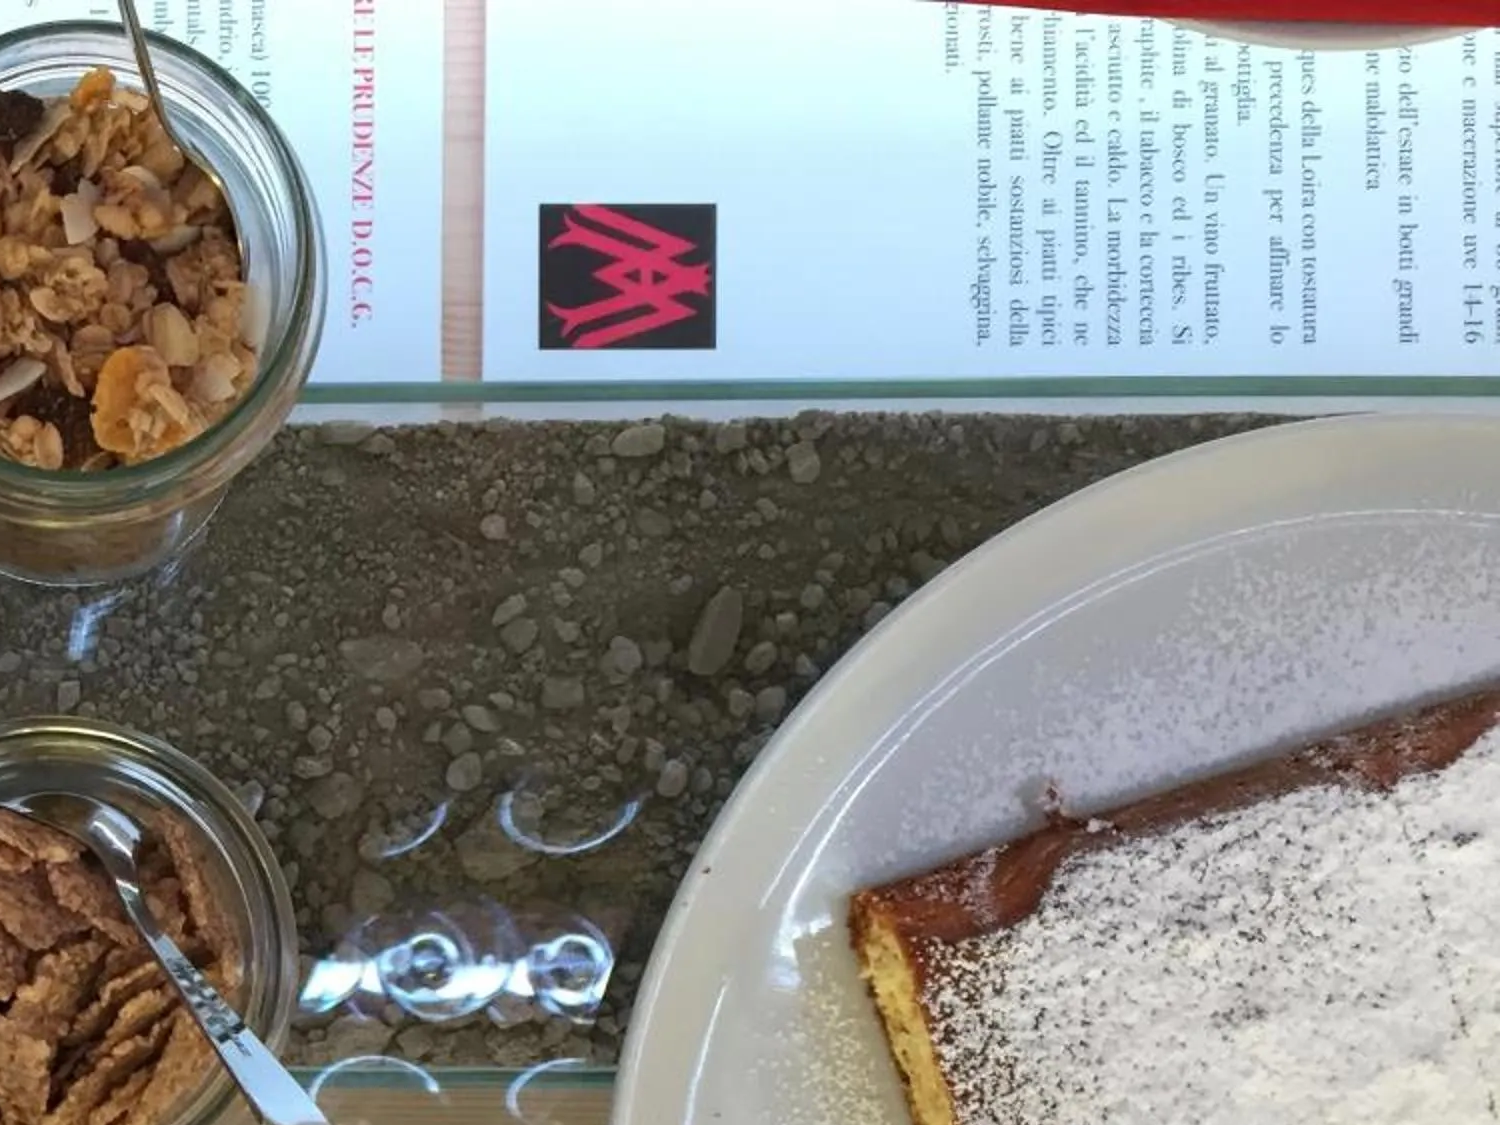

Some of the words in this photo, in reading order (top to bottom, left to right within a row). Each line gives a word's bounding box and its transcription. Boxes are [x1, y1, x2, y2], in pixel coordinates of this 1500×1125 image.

[1009, 77, 1030, 94] ai
[1204, 56, 1226, 72] al
[972, 70, 997, 148] pollame
[1139, 110, 1160, 123] il
[1171, 90, 1194, 109] di
[351, 68, 375, 210] PRUDENZE
[1004, 109, 1030, 161] piatti
[1074, 119, 1095, 144] ed
[1301, 101, 1322, 147] della
[1365, 82, 1387, 190] malolattica
[1042, 130, 1064, 184] Oltre
[1075, 156, 1095, 168] il
[1107, 129, 1128, 187] caldo.
[1139, 130, 1160, 207] tabacco
[1171, 124, 1193, 182] bosco
[1463, 99, 1482, 224] macerazione
[1204, 173, 1225, 203] Un
[1301, 155, 1322, 208] Loira
[1398, 195, 1418, 214] in
[1042, 198, 1062, 215] ai
[1073, 179, 1091, 263] tannino,
[1107, 198, 1129, 223] La
[1171, 196, 1193, 220] ed
[1262, 189, 1284, 223] per
[1008, 175, 1030, 285] sostanziosi
[1139, 231, 1160, 248] la
[1204, 212, 1224, 255] vino
[1301, 214, 1318, 250] con
[1398, 223, 1420, 271] botti
[1463, 235, 1478, 269] uve
[1035, 229, 1062, 281] piatti
[1268, 236, 1291, 311] affinare
[1074, 274, 1095, 310] che
[1107, 230, 1128, 345] morbidezza
[1139, 254, 1160, 345] corteccia
[1171, 255, 1193, 310] ribes.
[1301, 257, 1319, 344] tostatura
[1008, 299, 1030, 346] della
[1035, 294, 1062, 346] tipici
[1074, 322, 1091, 346] ne
[1171, 325, 1194, 344] Si
[1269, 325, 1290, 344] lo
[1393, 279, 1420, 344] grandi
